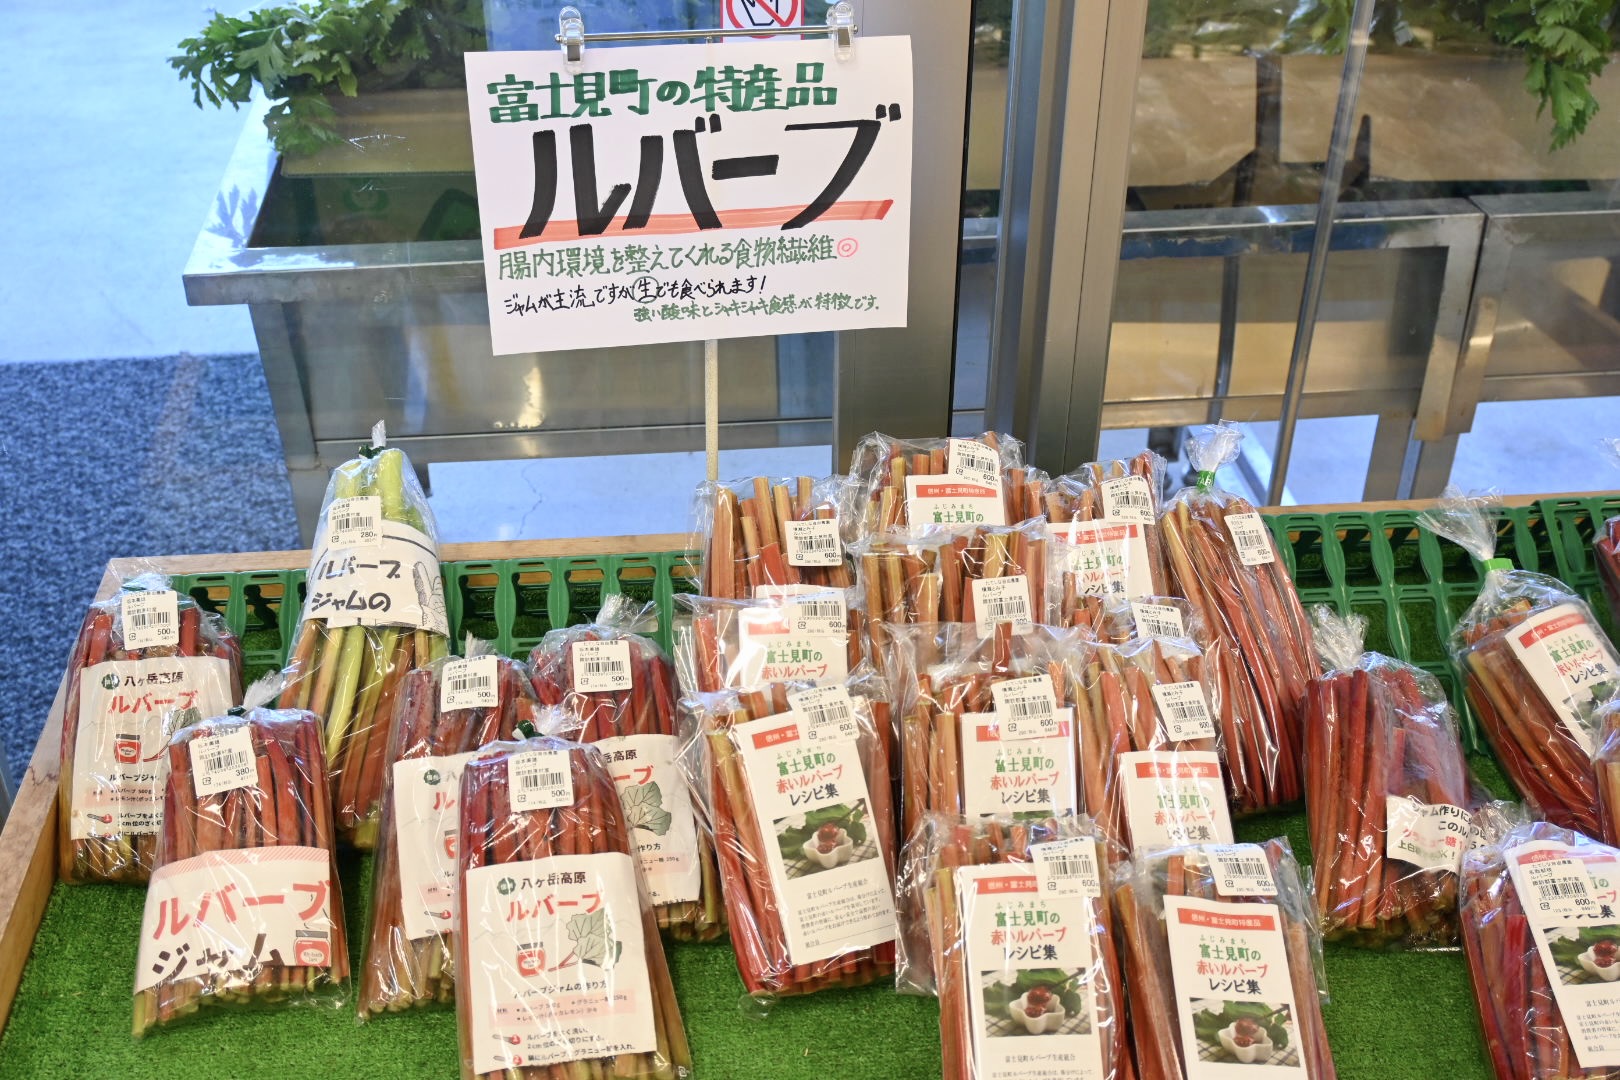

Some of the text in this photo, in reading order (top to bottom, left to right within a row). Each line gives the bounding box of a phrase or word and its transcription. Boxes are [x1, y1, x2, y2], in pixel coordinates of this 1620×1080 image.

[487, 62, 837, 123] 富士見町の特産品
[518, 103, 901, 239] ルバーブ
[499, 234, 837, 281] 腸内環境を整えてくれる食物繊維
[933, 511, 984, 523] 富士見町の
[312, 590, 391, 613] ジャムの
[766, 649, 823, 664] 富士見町の
[1550, 640, 1594, 664] 富士見町の
[762, 664, 828, 680] 赤いルバーブ
[1570, 662, 1609, 684] レシピ集
[108, 690, 199, 714] ルバーブ
[777, 752, 836, 776] 富士見町の
[995, 757, 1054, 773] 富士見町の
[776, 764, 843, 794] 赤いルバーブ
[991, 772, 1060, 791] 赤いルバーブ
[790, 783, 839, 806] レシピ集
[1001, 788, 1051, 804] レシピ集
[521, 871, 587, 890] 八ヶ岳高原
[153, 880, 331, 940] ルバーブ
[507, 889, 604, 922] ルバーブ
[995, 911, 1060, 927] 富士見町の
[991, 926, 1067, 946] 赤いルバーブ
[1004, 944, 1058, 960] レシピ集
[1198, 944, 1261, 962] 富士見町の
[1196, 960, 1268, 978] 赤いルバーブ
[1209, 978, 1262, 995] レシピ集
